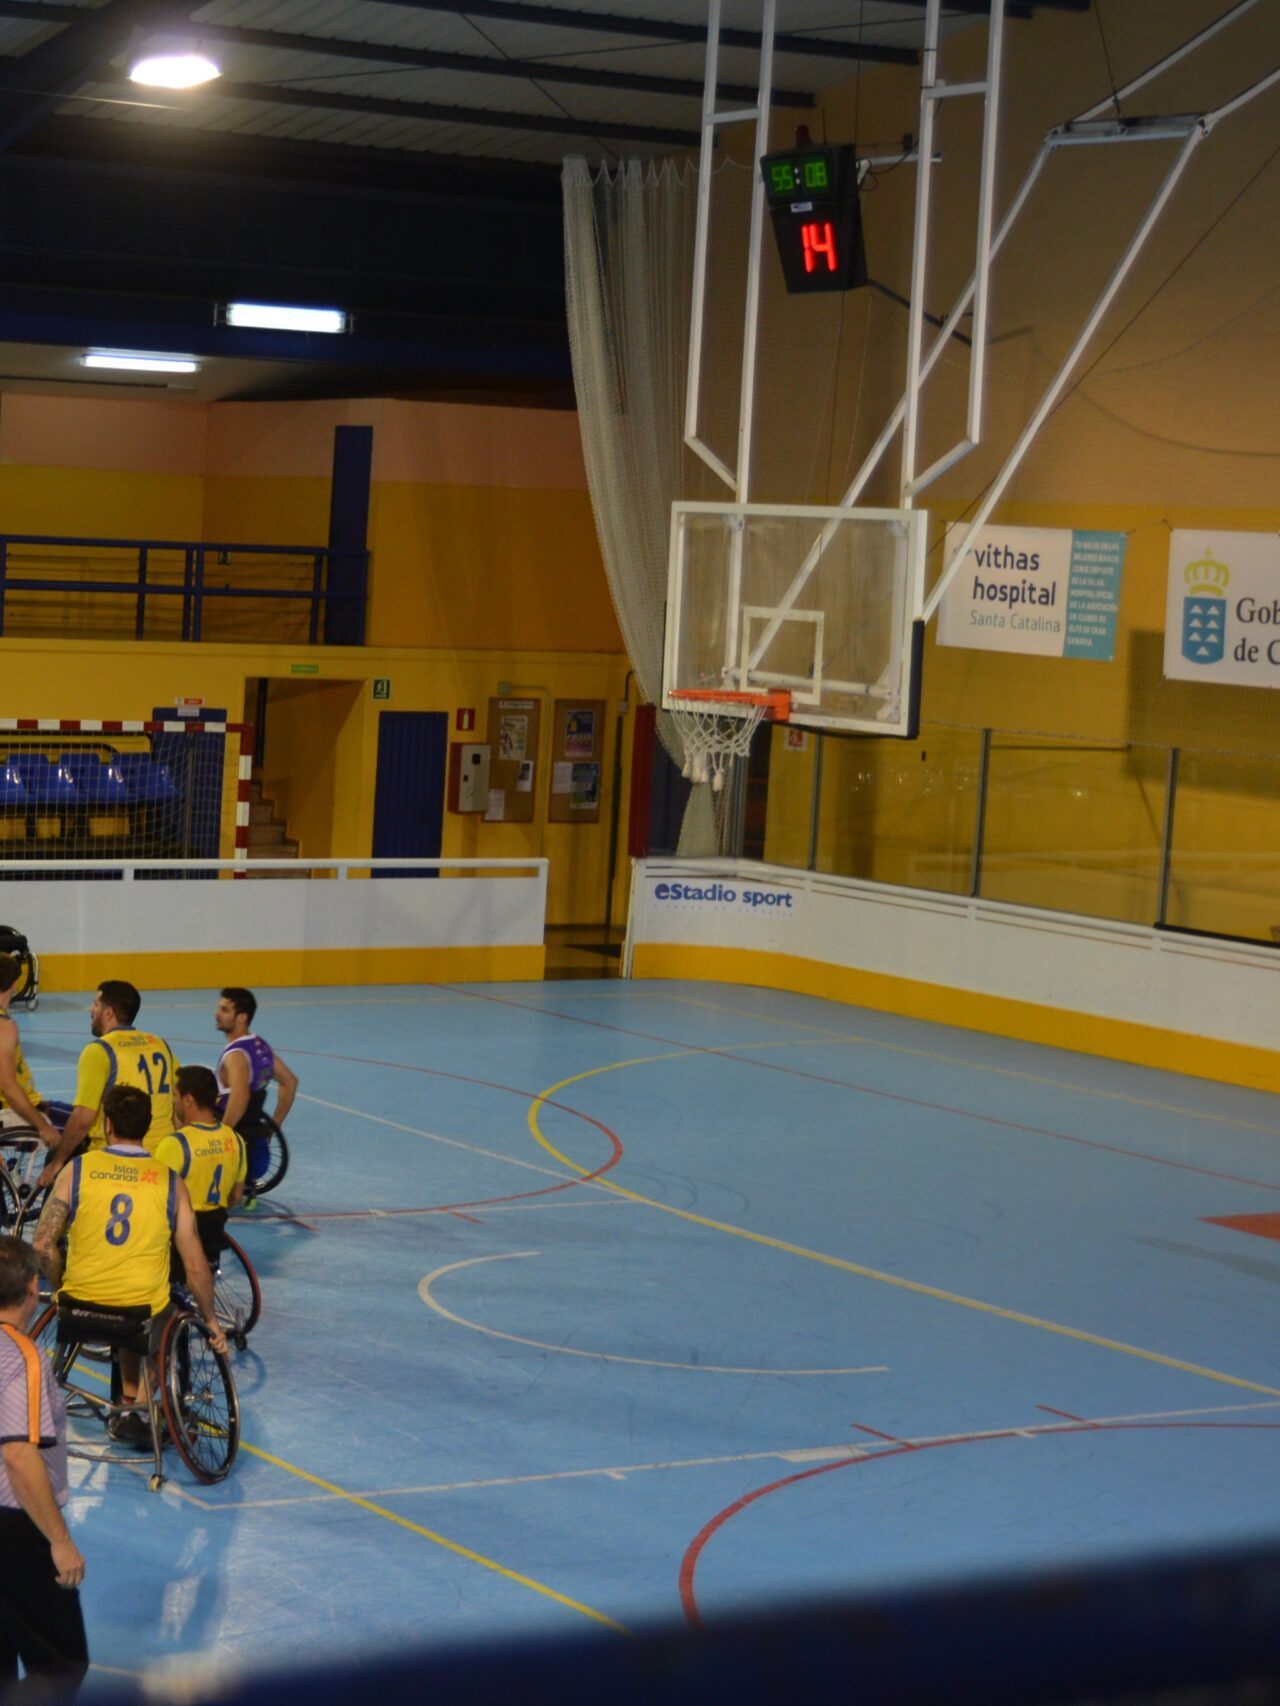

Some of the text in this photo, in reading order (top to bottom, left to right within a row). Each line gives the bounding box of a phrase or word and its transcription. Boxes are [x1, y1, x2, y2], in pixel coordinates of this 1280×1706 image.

[772, 162, 828, 190] 55:08
[802, 222, 837, 273] 14
[974, 543, 1040, 571] vithas
[972, 576, 1056, 609] hospital
[970, 609, 1061, 633] Santa Catalina
[1233, 637, 1259, 663] de
[654, 883, 793, 908] eStadio sport
[138, 1052, 170, 1095] 12
[89, 1170, 139, 1183] Canarias
[113, 1164, 139, 1175] Islas
[207, 1163, 223, 1205] 4
[105, 1193, 134, 1246] 8
